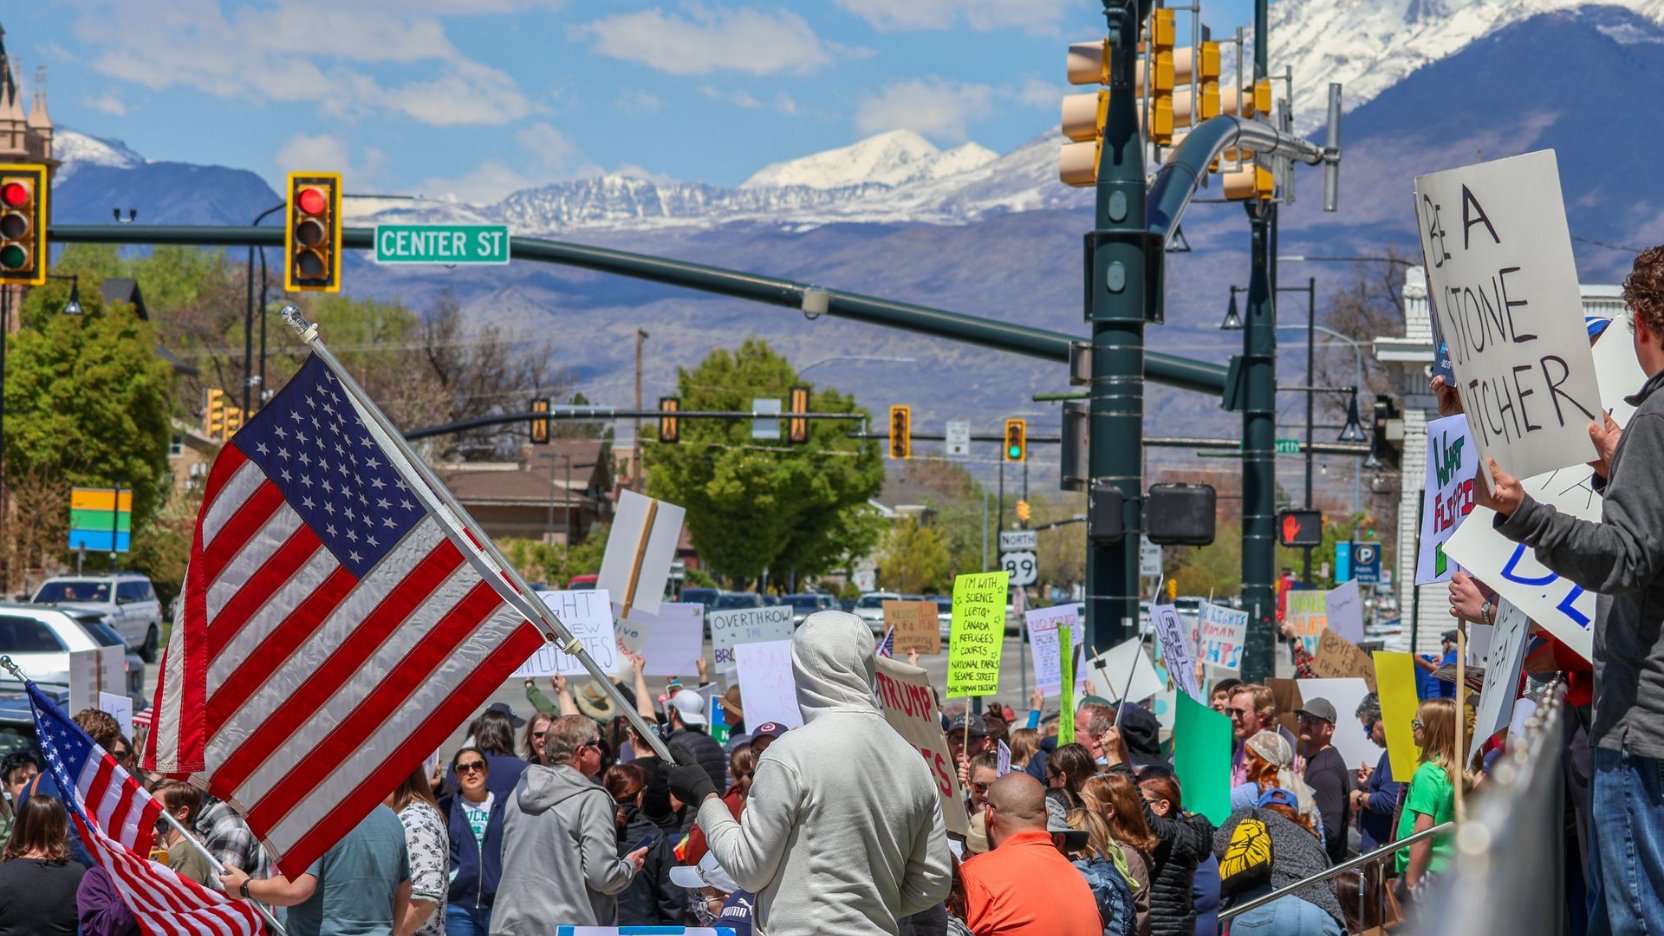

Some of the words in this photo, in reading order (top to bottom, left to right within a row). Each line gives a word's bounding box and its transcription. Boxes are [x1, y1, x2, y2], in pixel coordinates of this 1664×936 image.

[1424, 193, 1451, 269] BE
[1462, 183, 1501, 250] A
[381, 230, 467, 257] CENTER
[477, 231, 503, 257] ST
[1445, 266, 1538, 366] STONE
[1460, 355, 1596, 447] ITCHER
[1275, 442, 1299, 453] orth
[1002, 534, 1035, 546] NORTH
[1006, 559, 1033, 579] 89
[964, 577, 977, 589] I'M
[978, 577, 998, 589] WITH
[965, 592, 995, 604] SCIENCE
[714, 609, 791, 631] OVERTHROW
[963, 620, 990, 631] CANADA
[959, 632, 995, 645] REFUGEES
[960, 645, 988, 656] COURTS
[975, 672, 996, 682] STREET
[876, 671, 932, 724] TRUMP
[720, 906, 748, 918] PUMA
